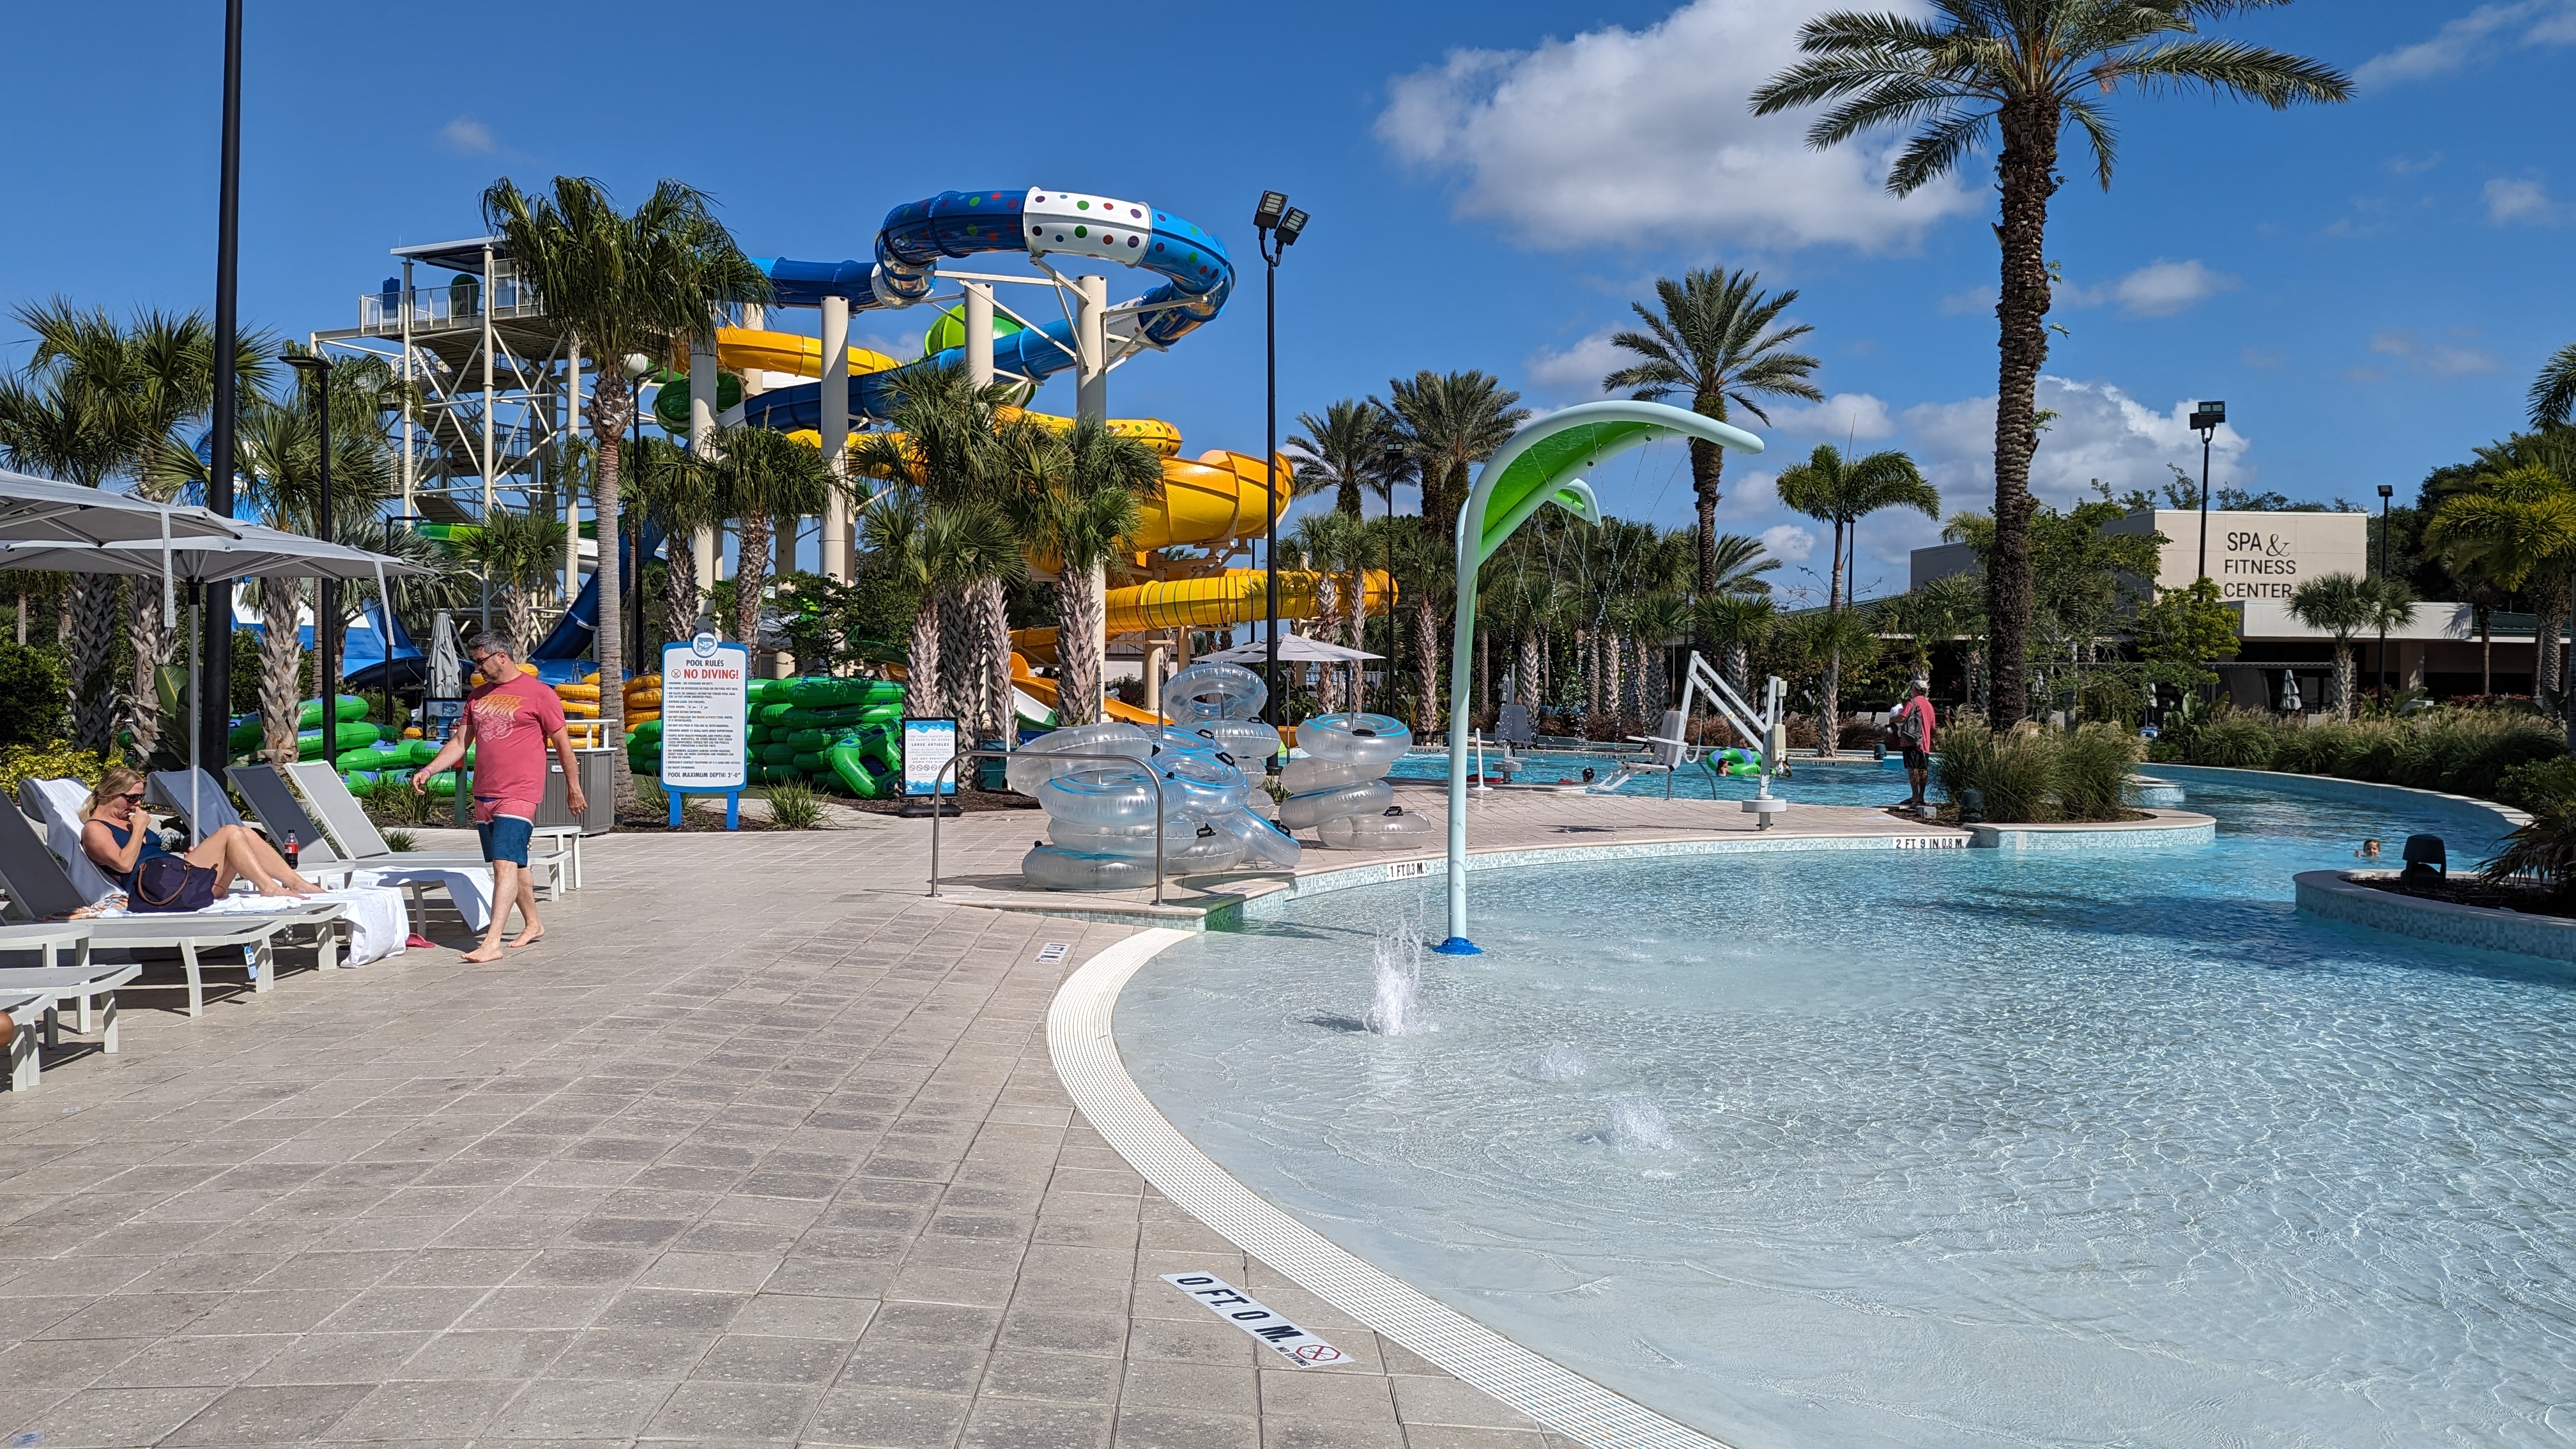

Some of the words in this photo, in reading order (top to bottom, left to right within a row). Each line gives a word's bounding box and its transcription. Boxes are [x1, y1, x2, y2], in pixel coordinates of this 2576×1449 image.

[2227, 532, 2262, 551] SPA
[2266, 533, 2291, 556] &
[2225, 559, 2296, 574] FITNESS
[2224, 583, 2292, 598] CENTER
[684, 669, 698, 678] NO
[702, 669, 739, 679] DIVING!
[480, 703, 523, 721] MAN
[1896, 839, 1901, 848] 2
[1905, 839, 1916, 849] FT.
[1920, 838, 1926, 848] 9
[1929, 838, 1940, 848] IN.
[1942, 838, 1952, 848] 0.8
[1955, 838, 1964, 848] M.
[1390, 866, 1393, 877] 1
[1397, 864, 1406, 877] FT.
[1406, 863, 1415, 876] 0.3
[1416, 862, 1424, 875] M.
[1176, 1276, 1214, 1285] 0
[1193, 1289, 1251, 1307] FT.
[1231, 1310, 1270, 1321] 0
[1254, 1325, 1305, 1343] M.
[1284, 1353, 1311, 1367] DIVING
